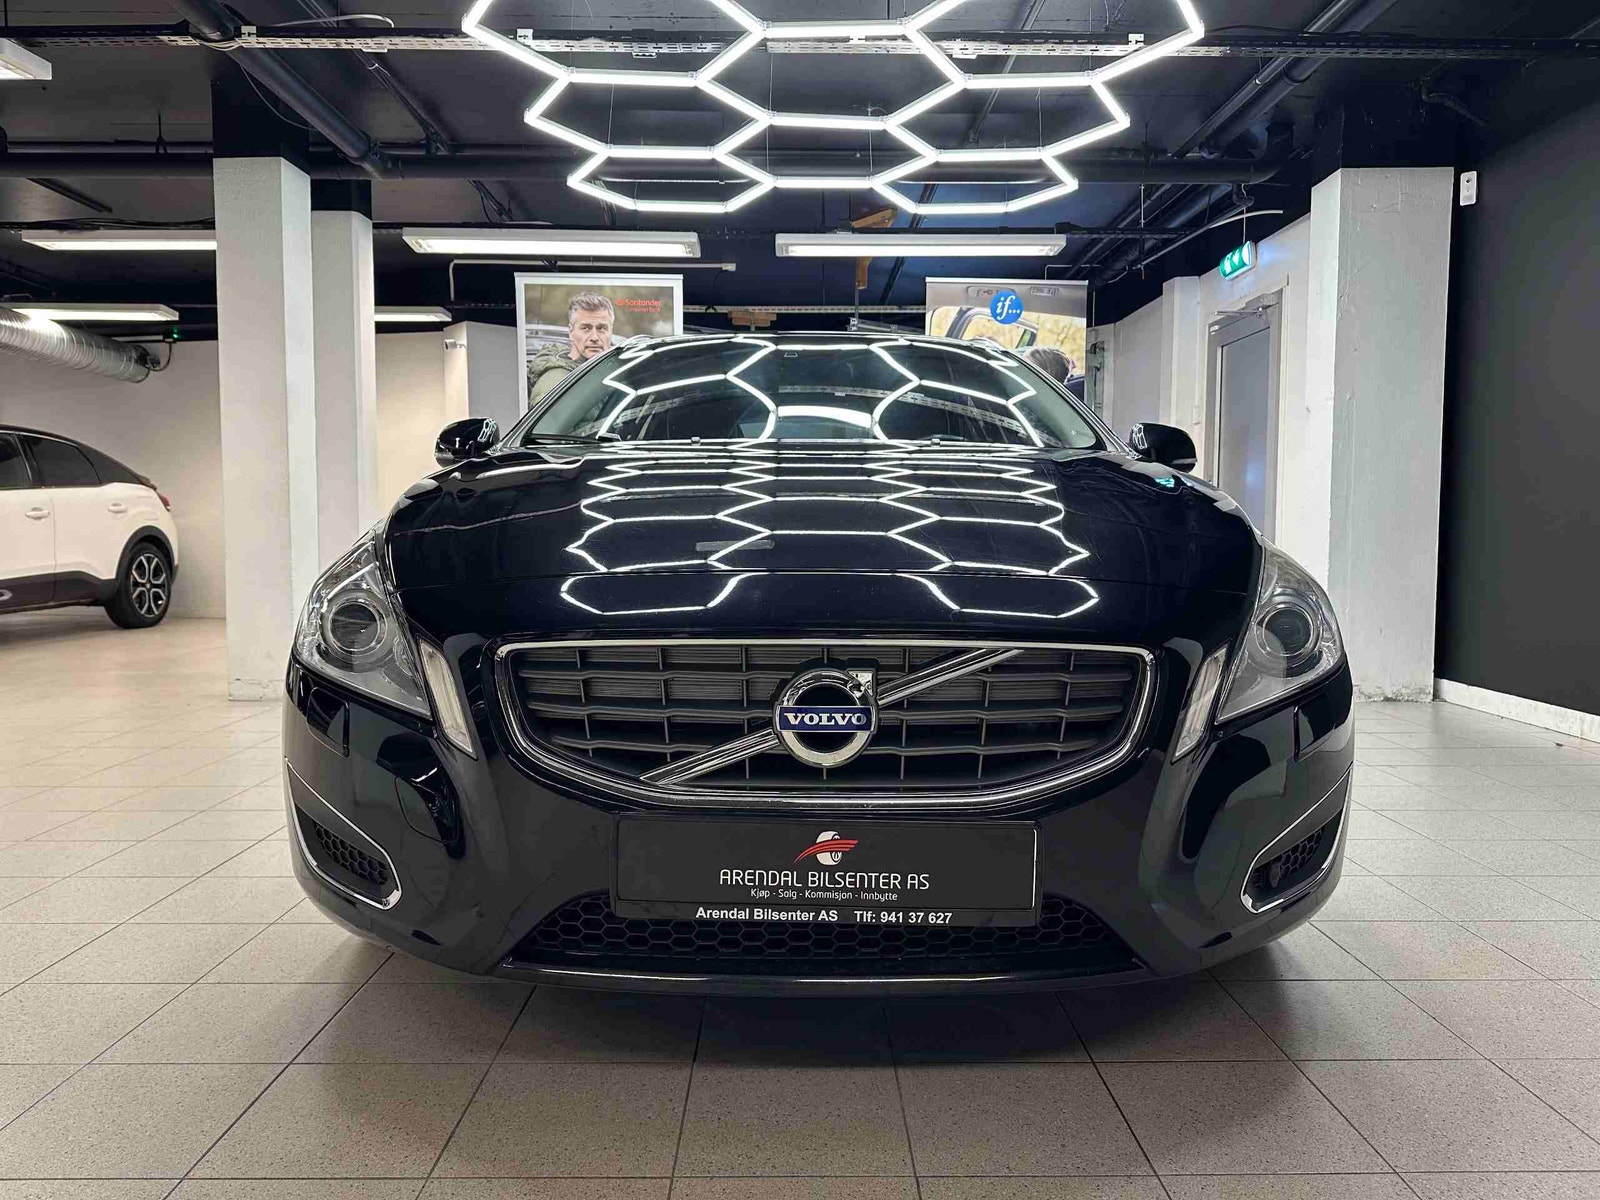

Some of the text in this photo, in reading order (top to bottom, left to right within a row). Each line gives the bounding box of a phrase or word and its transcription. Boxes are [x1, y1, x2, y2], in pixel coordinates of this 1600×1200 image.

[784, 713, 867, 725] VOLVO
[719, 869, 930, 890] ARENDAL BILSENTER AS
[750, 888, 771, 899] Kjøp
[778, 889, 797, 900] Salg
[805, 889, 853, 901] Kommisjon
[860, 891, 898, 902] Innbytte
[695, 906, 953, 924] Arendal Bilsenter AS Tlf: 941 37 627
